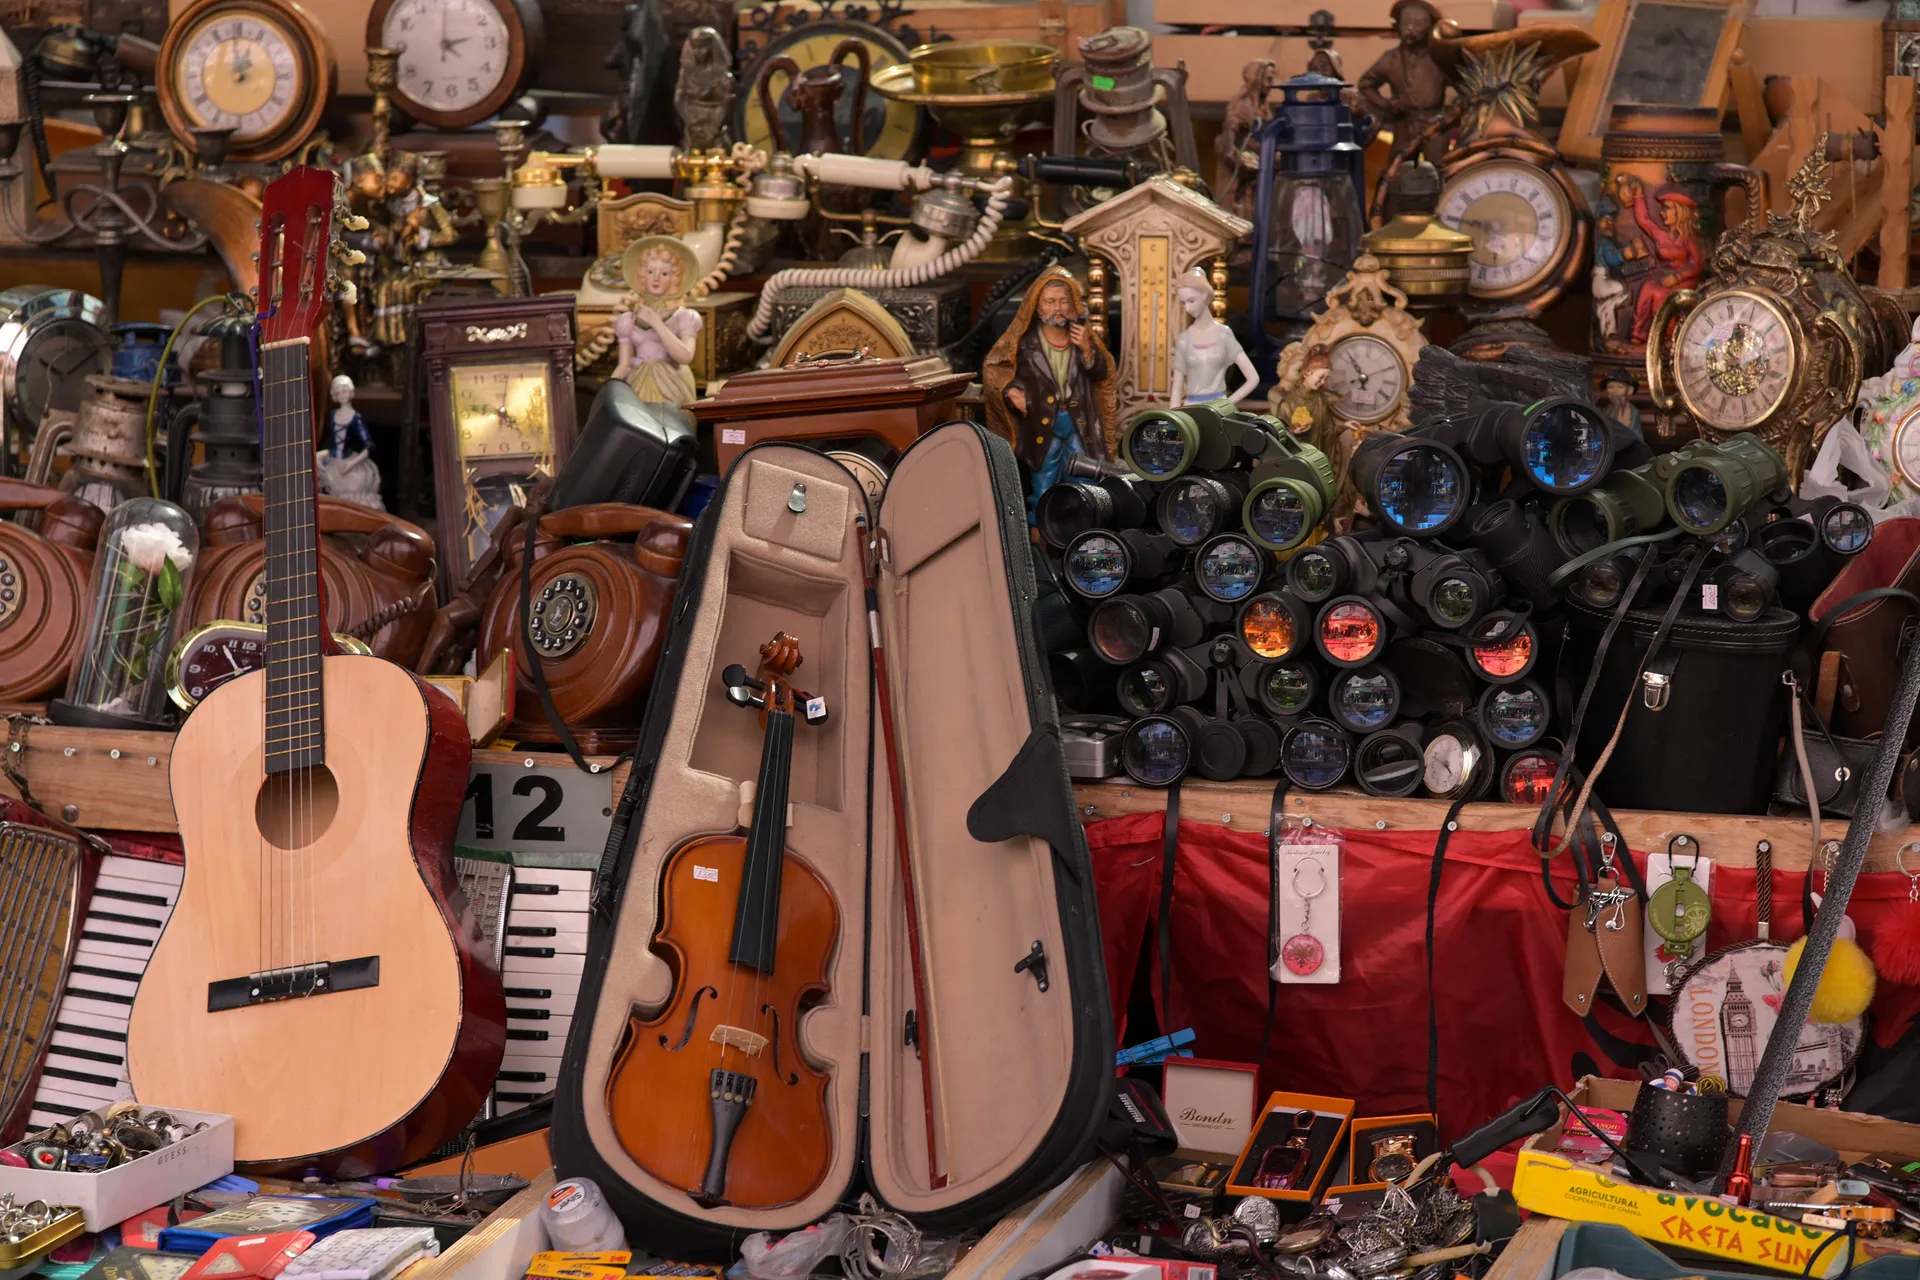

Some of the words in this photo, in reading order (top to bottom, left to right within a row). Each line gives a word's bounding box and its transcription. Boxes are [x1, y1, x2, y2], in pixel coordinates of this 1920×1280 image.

[867, 480, 878, 497] 2
[202, 643, 217, 654] 10
[228, 640, 239, 649] 11
[241, 641, 258, 652] 12
[188, 664, 202, 674] 9
[190, 686, 204, 697] 8
[465, 773, 565, 841] 12
[1689, 989, 1721, 1075] LONDON
[1180, 1107, 1236, 1125] Bondn
[157, 1146, 187, 1165] GUESS
[1564, 1193, 1606, 1208] COOPERATIVE
[1569, 1186, 1640, 1209] AGRICULTURAL
[1660, 1214, 1744, 1254] CRETA
[1757, 1237, 1812, 1267] SUN
